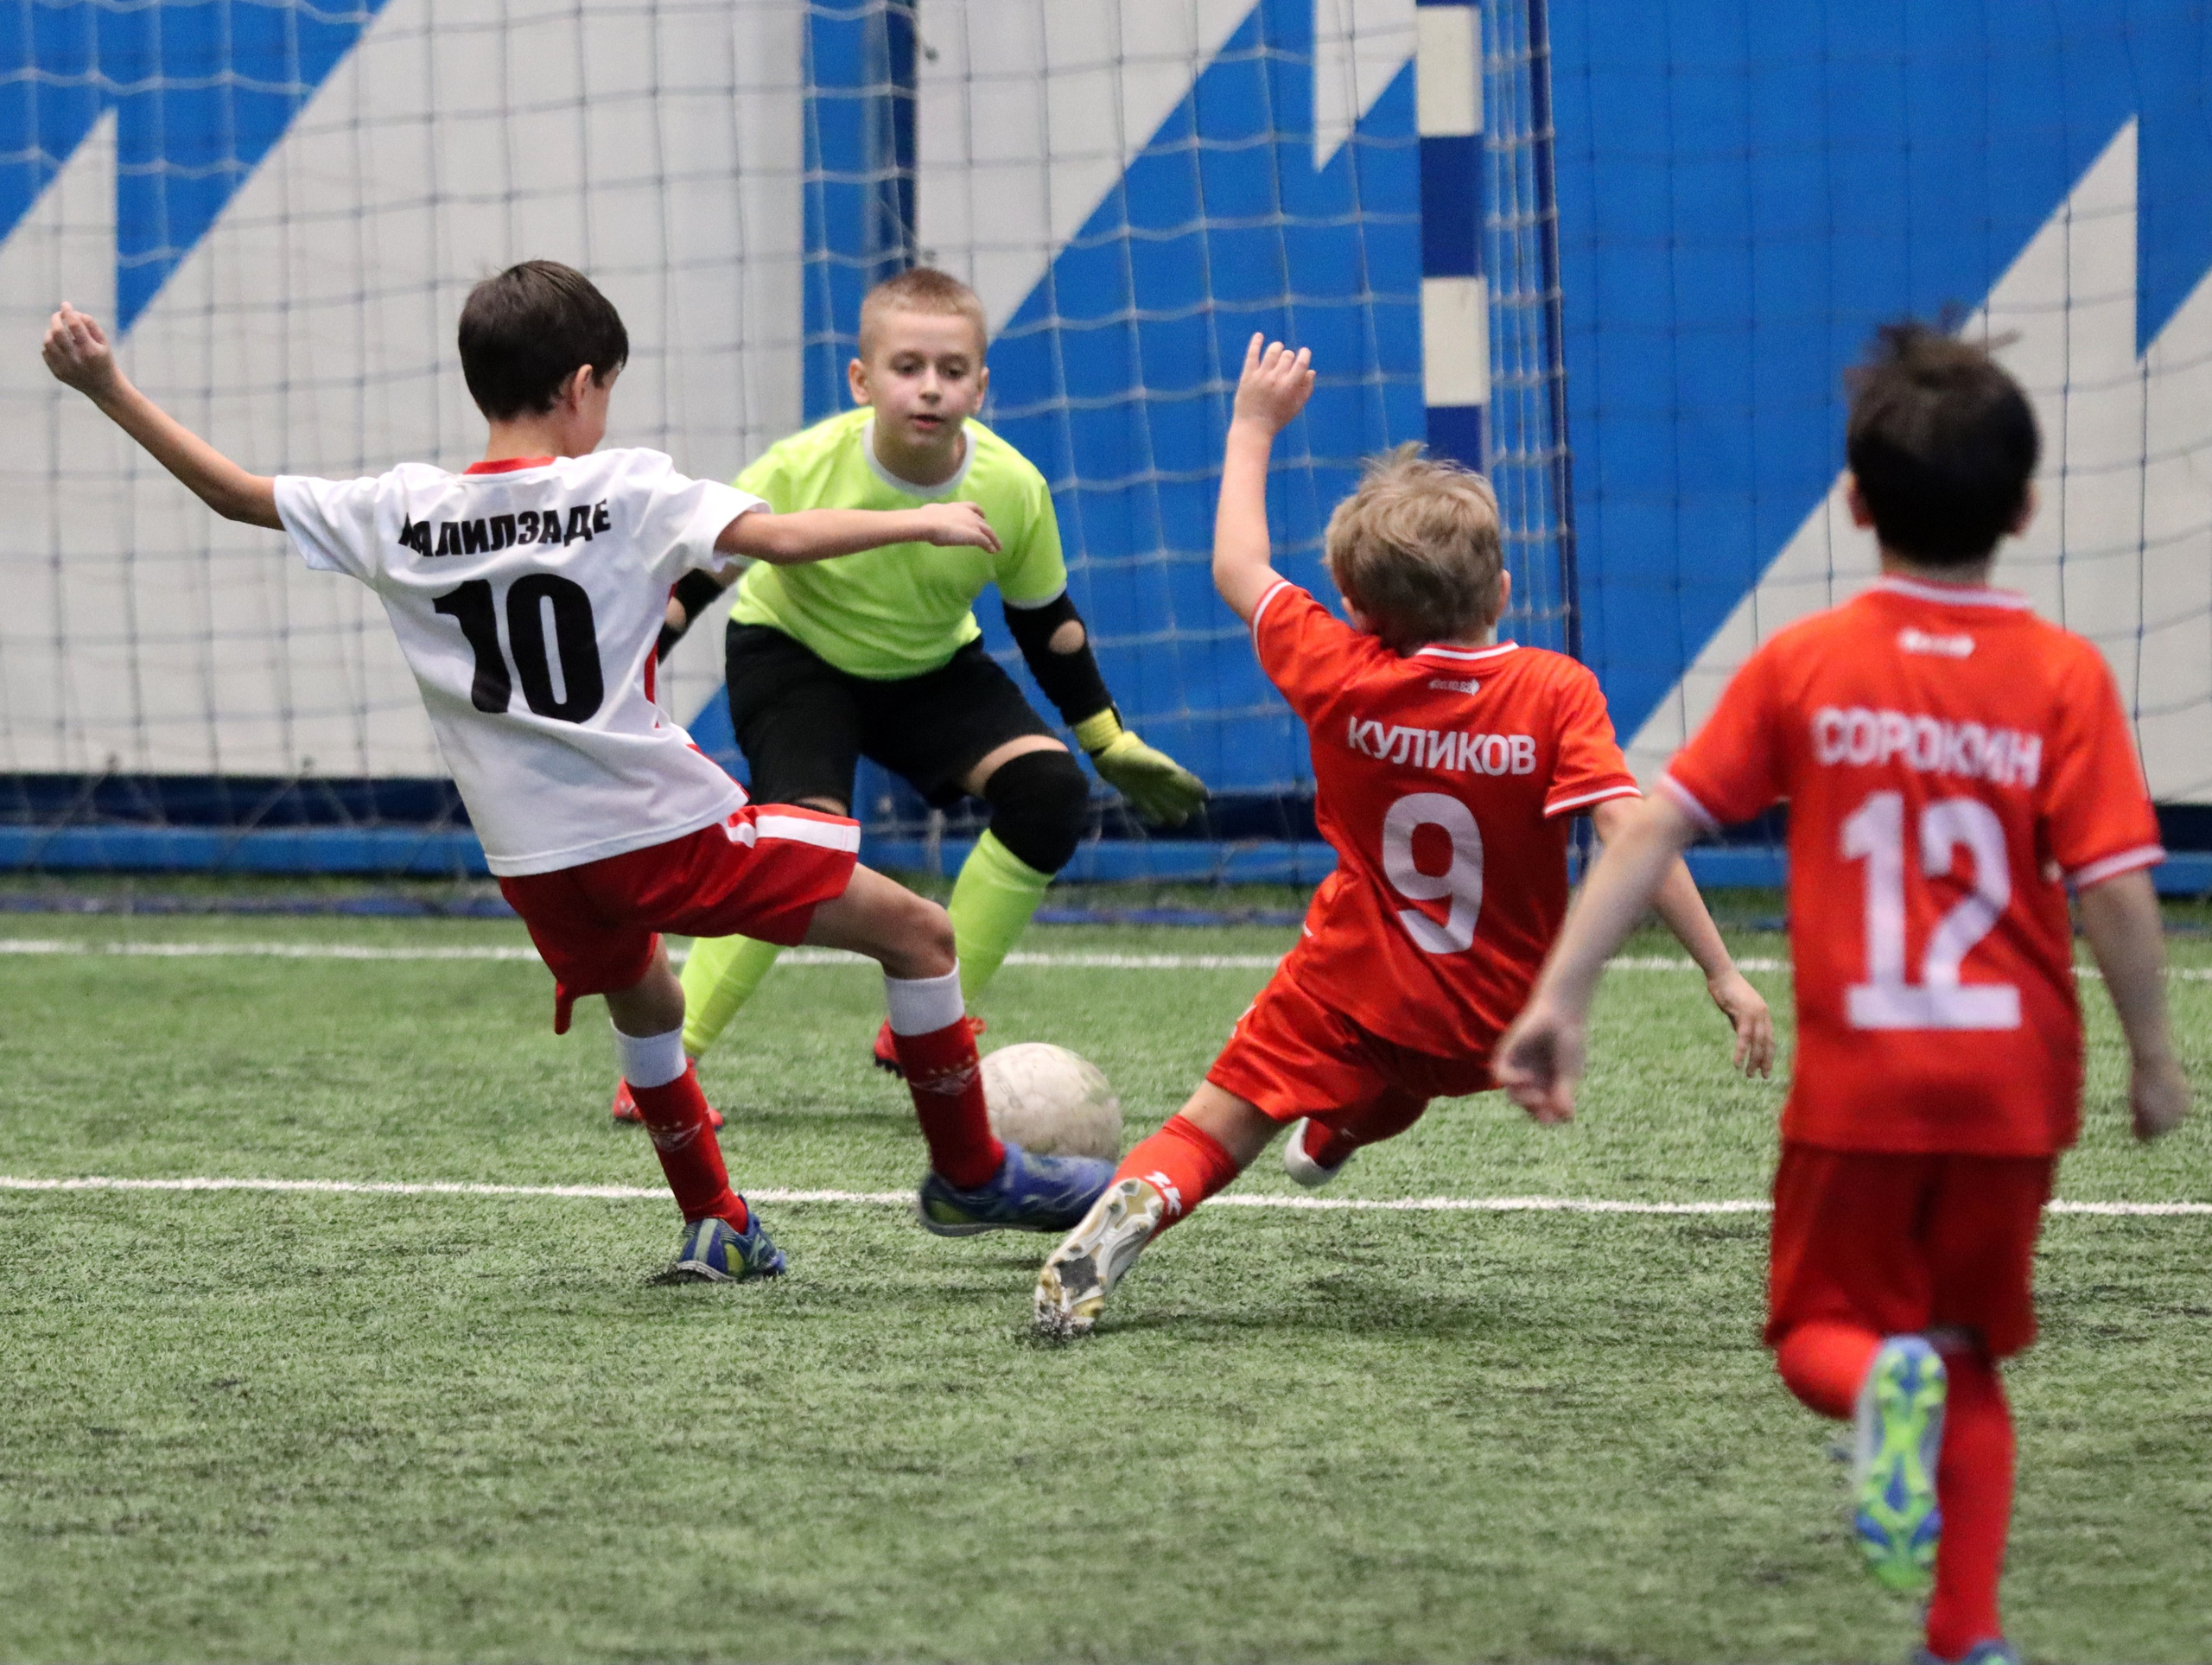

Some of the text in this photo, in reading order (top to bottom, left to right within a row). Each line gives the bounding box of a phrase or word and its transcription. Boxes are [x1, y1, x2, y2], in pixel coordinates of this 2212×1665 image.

[432, 573, 604, 724] 10
[1348, 716, 1536, 776] КУЛИКОВ
[1814, 707, 2043, 790] СОРОКИН
[1382, 792, 1484, 954] 9
[1841, 791, 2023, 1029] 12
